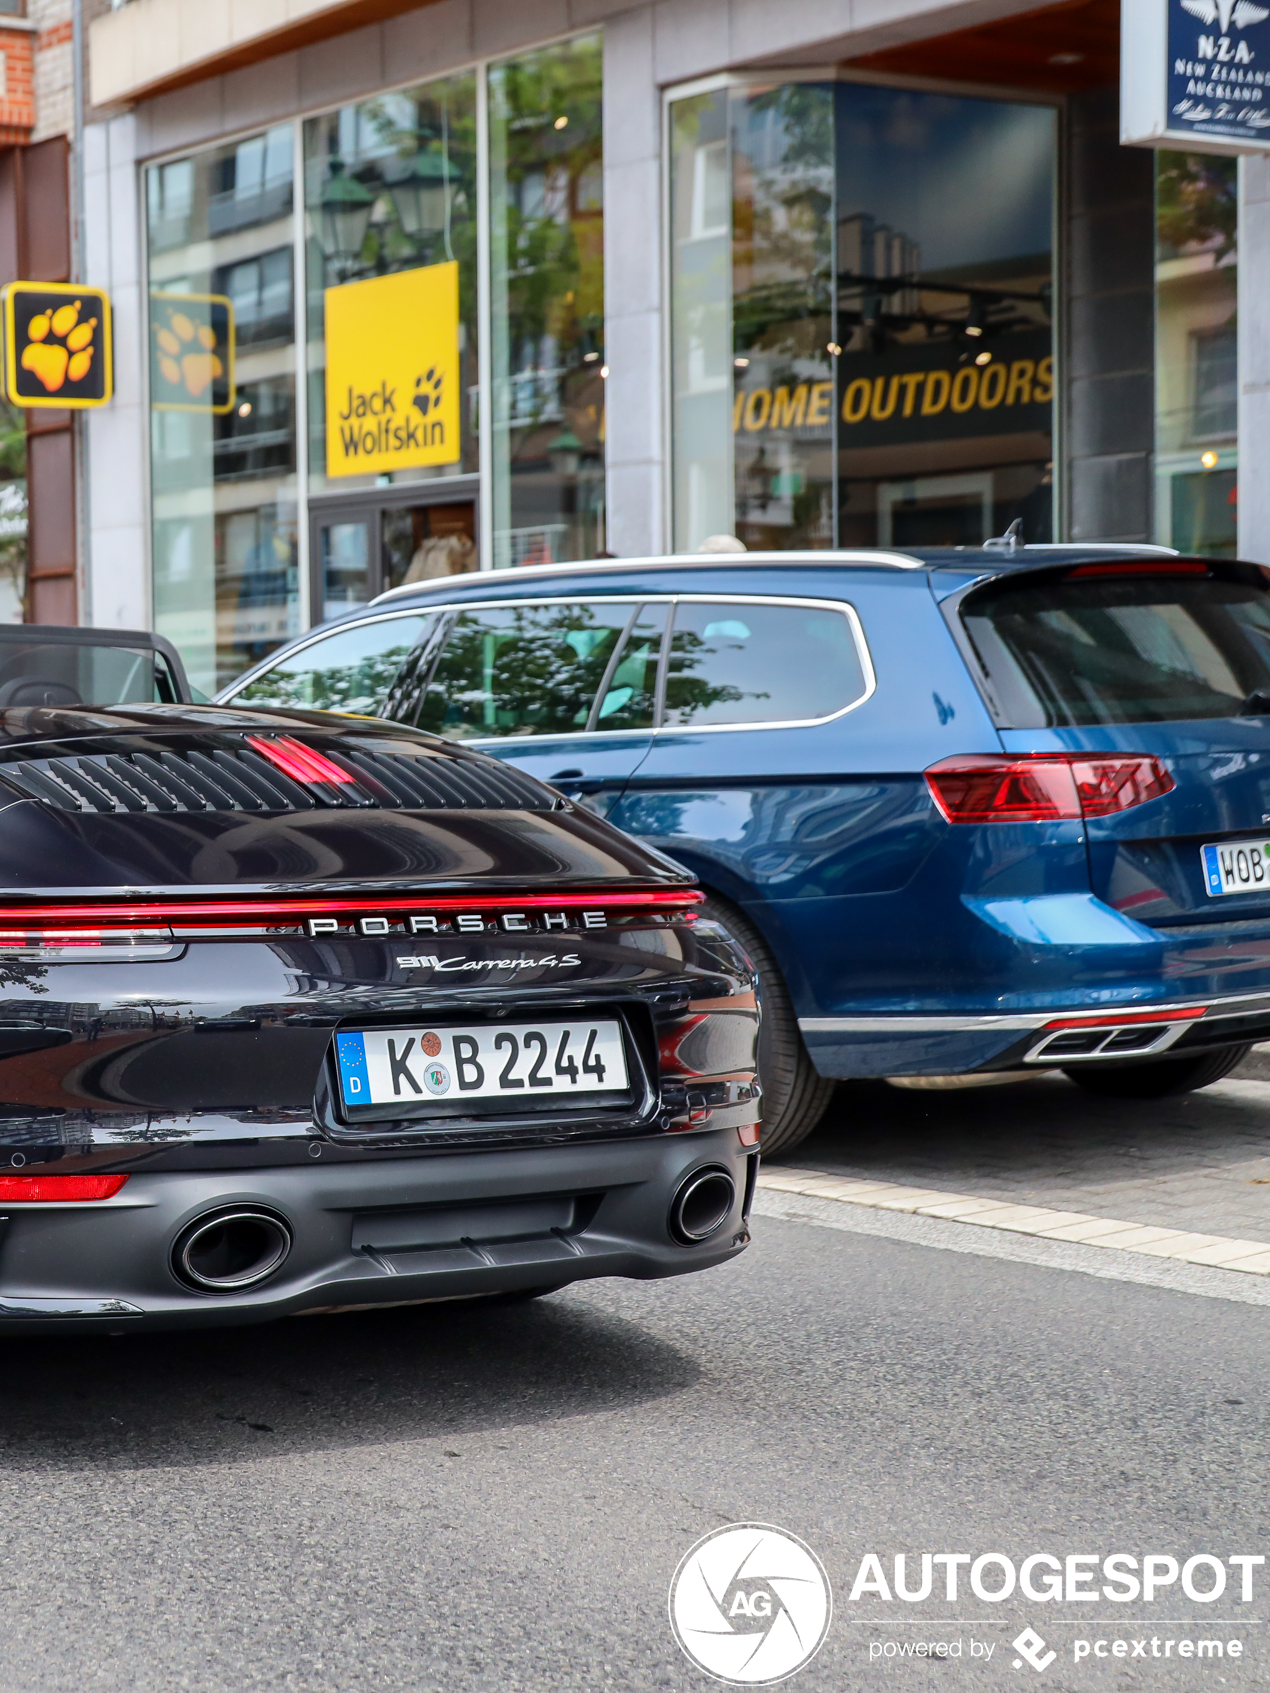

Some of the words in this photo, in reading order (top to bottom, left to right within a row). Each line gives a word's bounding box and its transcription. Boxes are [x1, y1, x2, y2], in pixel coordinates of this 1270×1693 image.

[339, 380, 396, 420] Jack
[842, 355, 1053, 424] OUTDOORS
[339, 415, 444, 457] Wolfskin
[1220, 848, 1264, 886] WOB
[308, 911, 607, 936] PORSCHE
[396, 955, 439, 970] 911
[434, 956, 538, 972] Carrera
[387, 1037, 423, 1095] K
[452, 1034, 485, 1091] B
[494, 1029, 606, 1089] 2244
[349, 1076, 362, 1094] D
